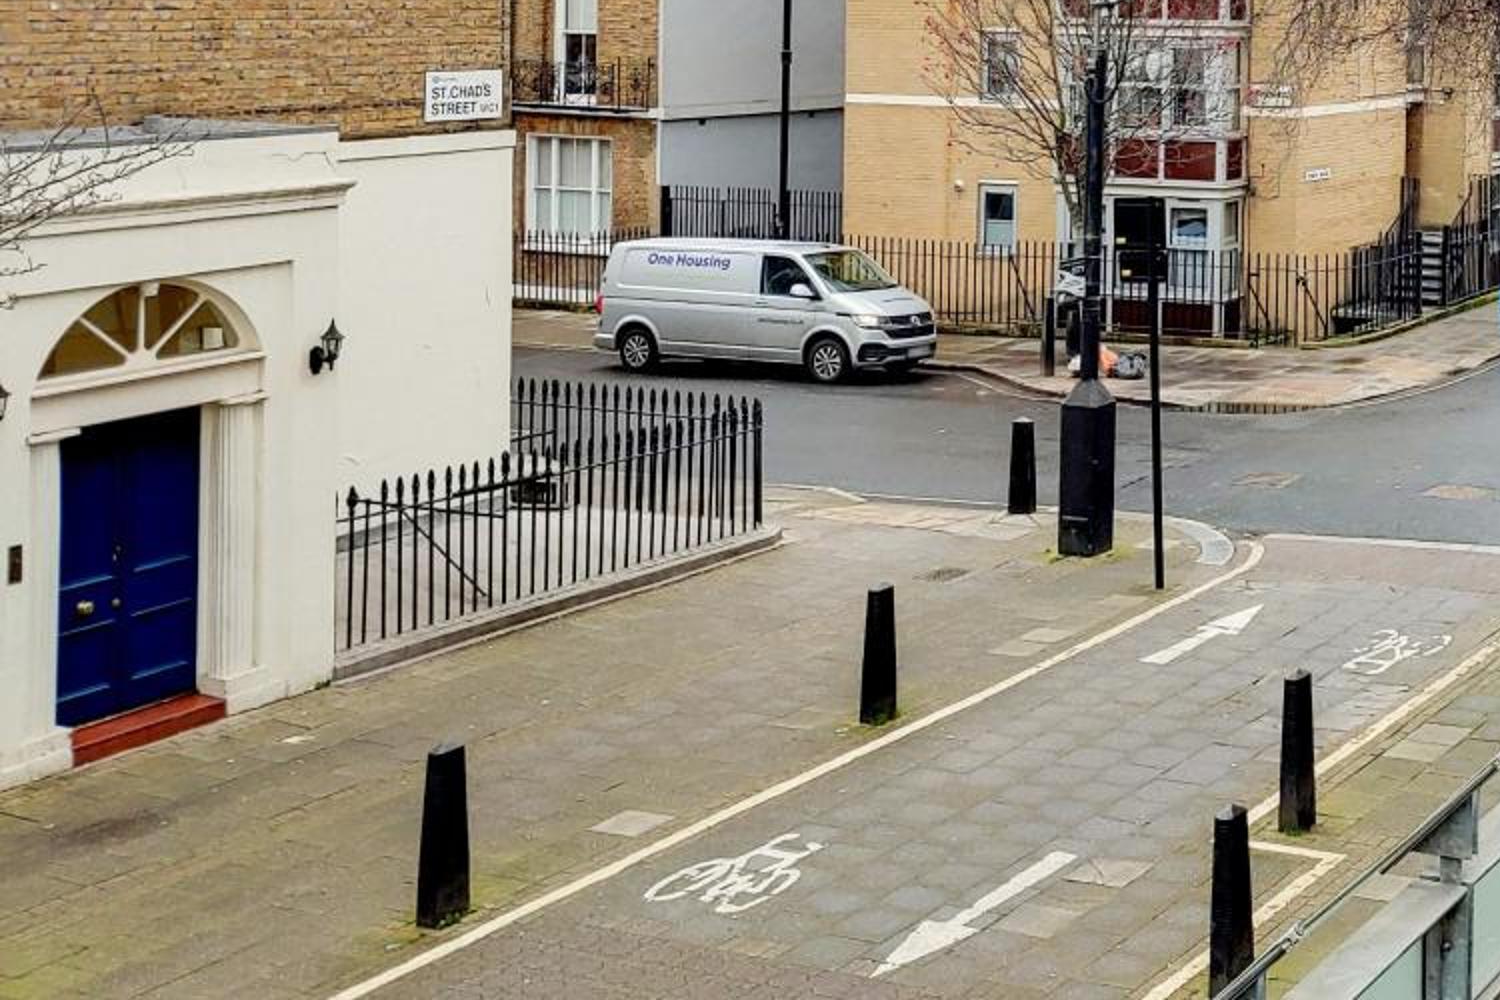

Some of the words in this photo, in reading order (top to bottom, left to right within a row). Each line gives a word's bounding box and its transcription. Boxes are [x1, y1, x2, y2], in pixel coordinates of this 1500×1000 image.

[432, 101, 477, 116] STREET
[647, 252, 674, 265] One
[676, 254, 731, 270] Housing
